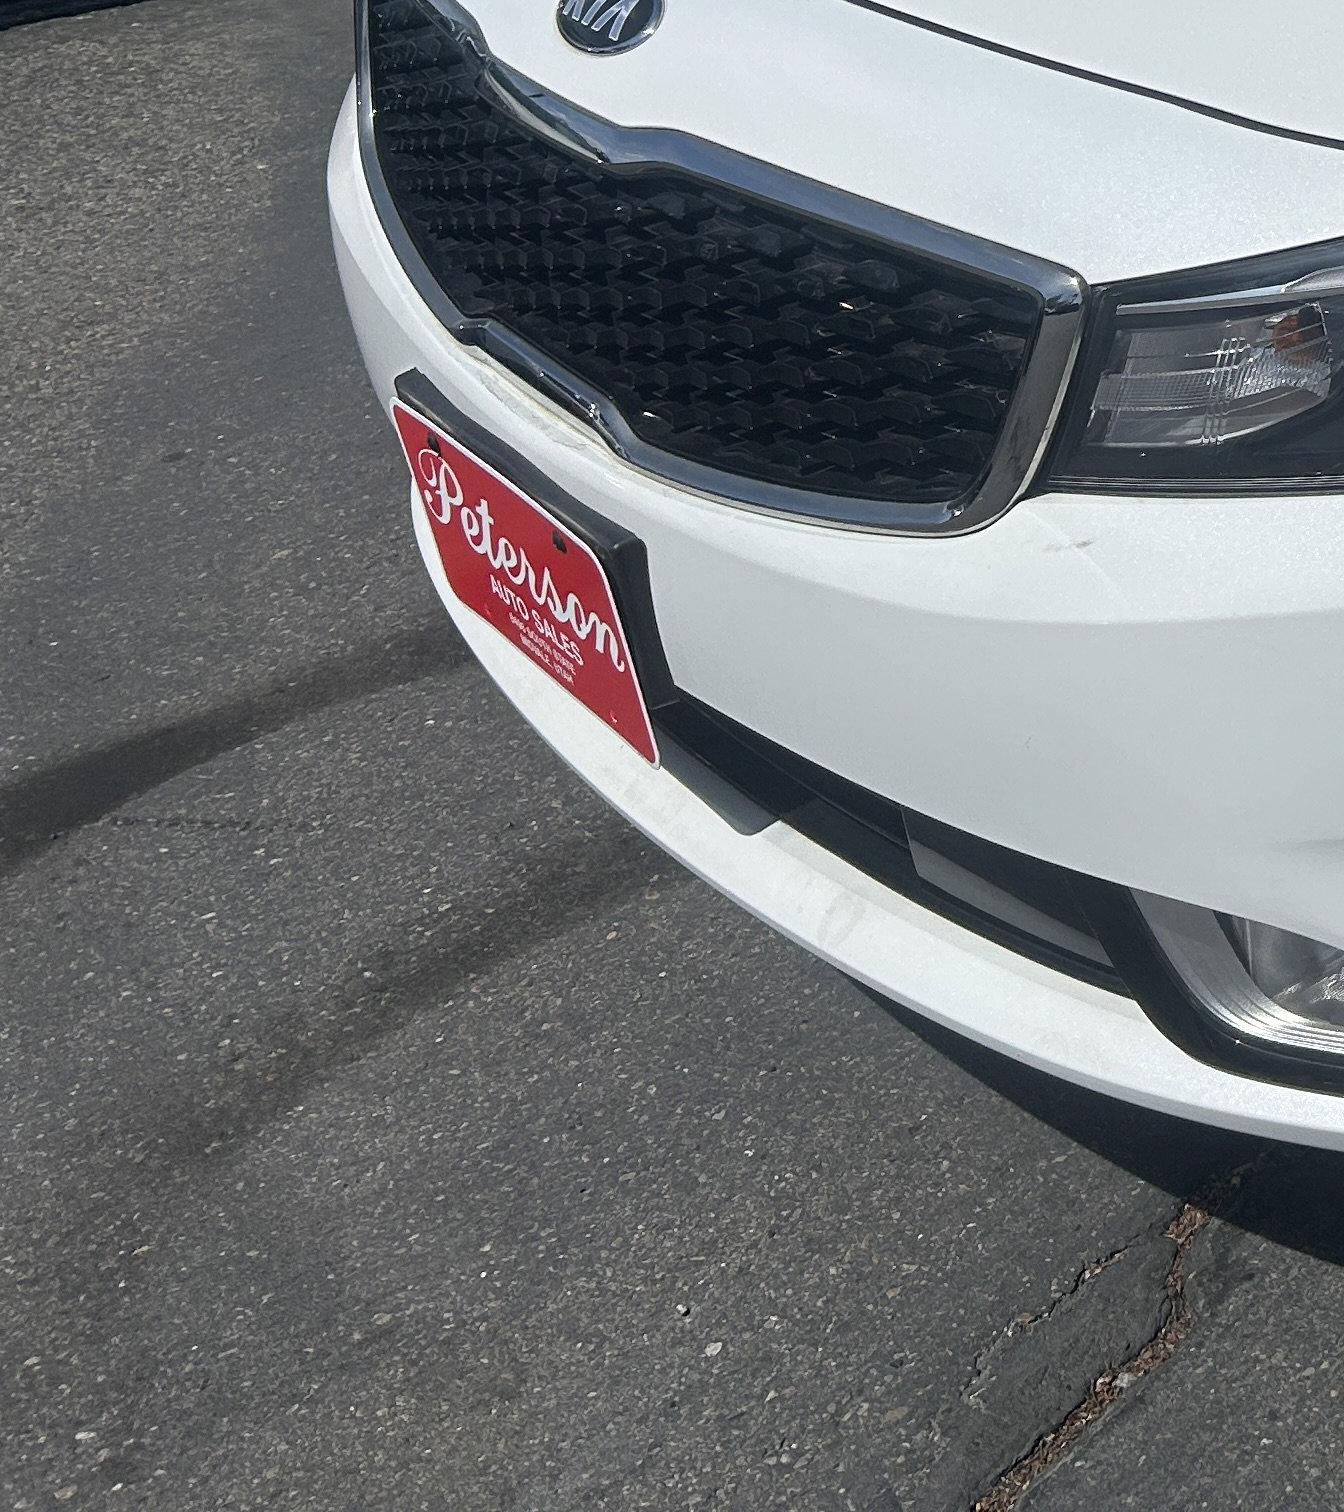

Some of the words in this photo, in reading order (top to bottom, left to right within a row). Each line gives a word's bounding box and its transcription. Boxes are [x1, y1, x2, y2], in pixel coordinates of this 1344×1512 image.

[418, 448, 625, 673] Peterson
[490, 574, 529, 621] AUTO
[531, 609, 584, 666] SALES
